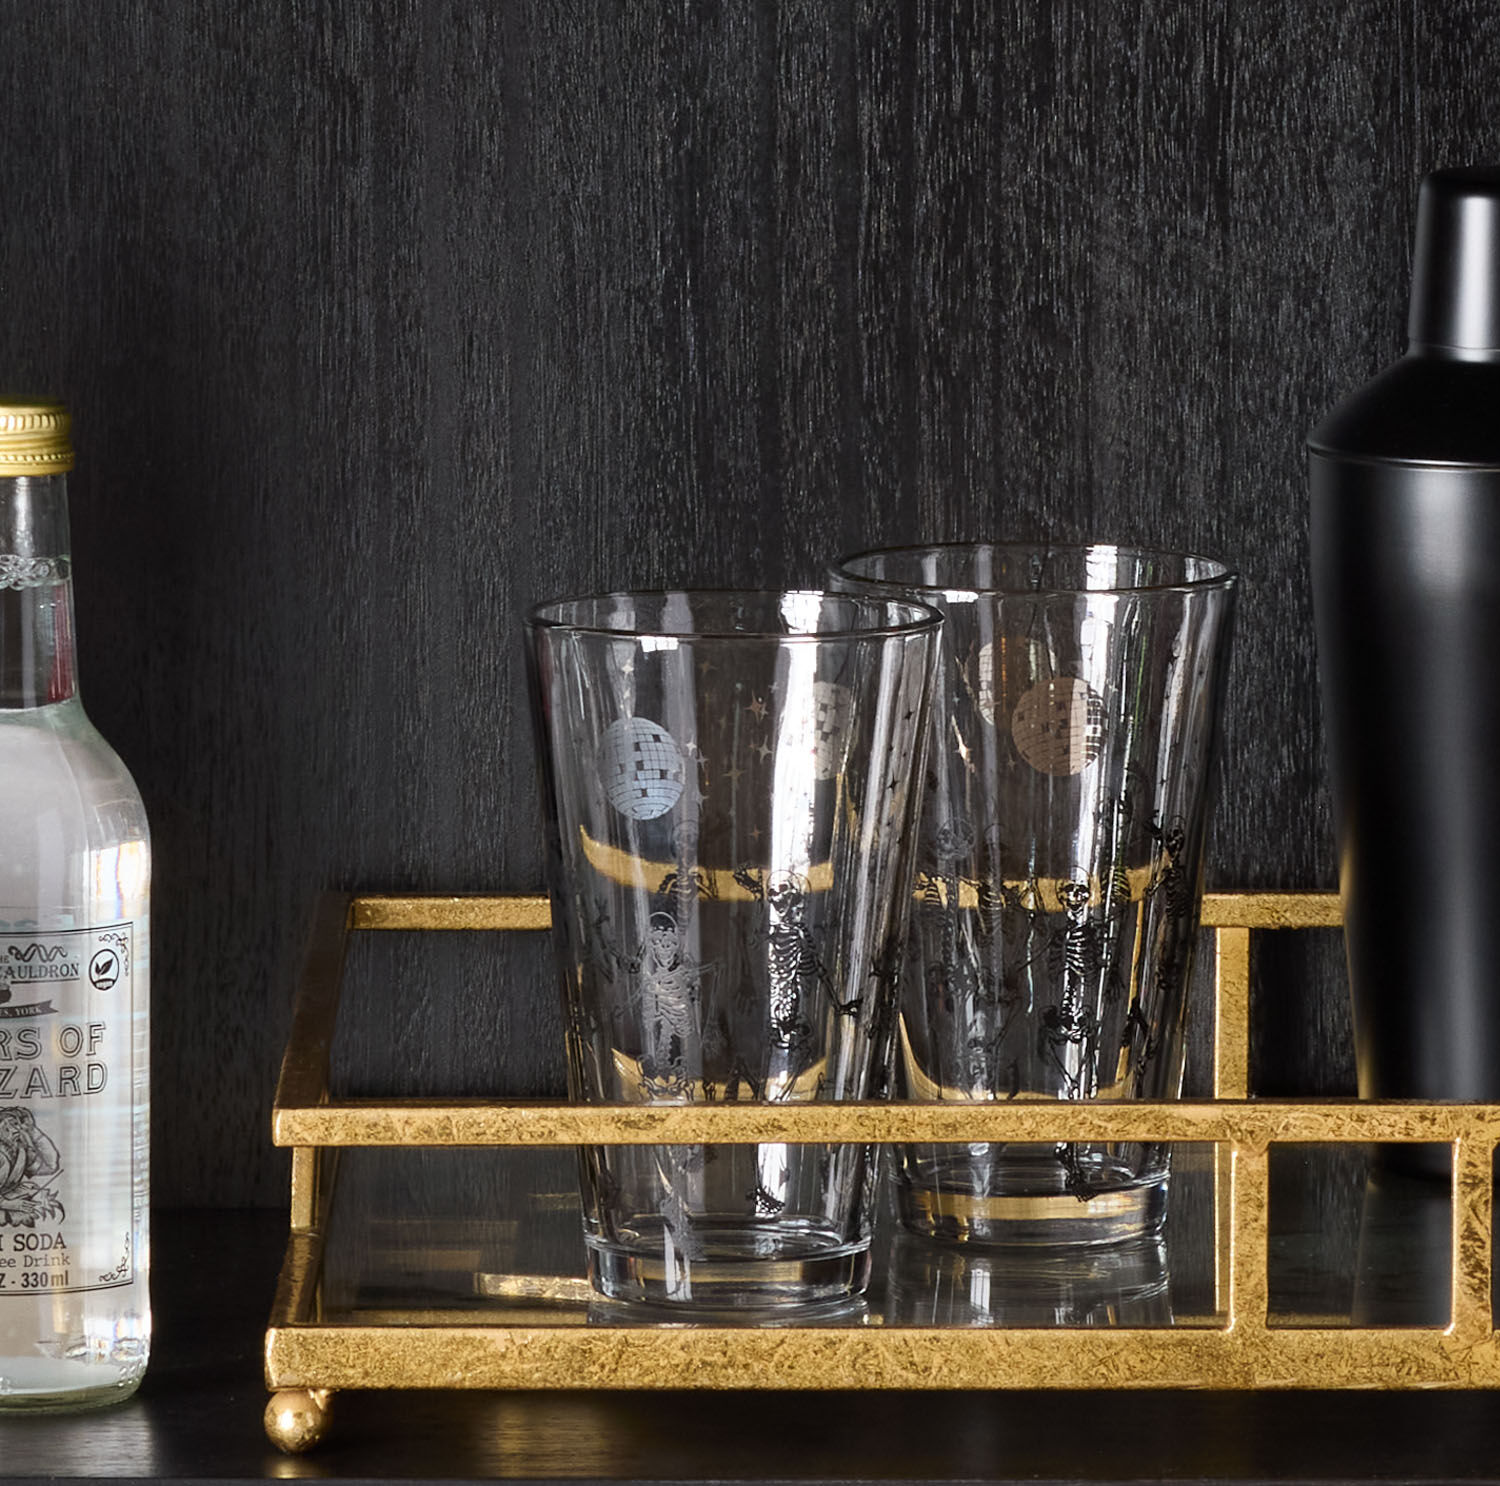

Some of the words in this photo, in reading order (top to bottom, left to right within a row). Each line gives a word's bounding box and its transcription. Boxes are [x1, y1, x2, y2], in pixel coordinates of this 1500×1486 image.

[0, 963, 79, 979] AULDRON
[15, 1005, 42, 1016] YORK
[57, 1021, 106, 1058] OF
[14, 1232, 67, 1252] SODA
[24, 1253, 71, 1268] Drink
[21, 1270, 69, 1288] 330ml
